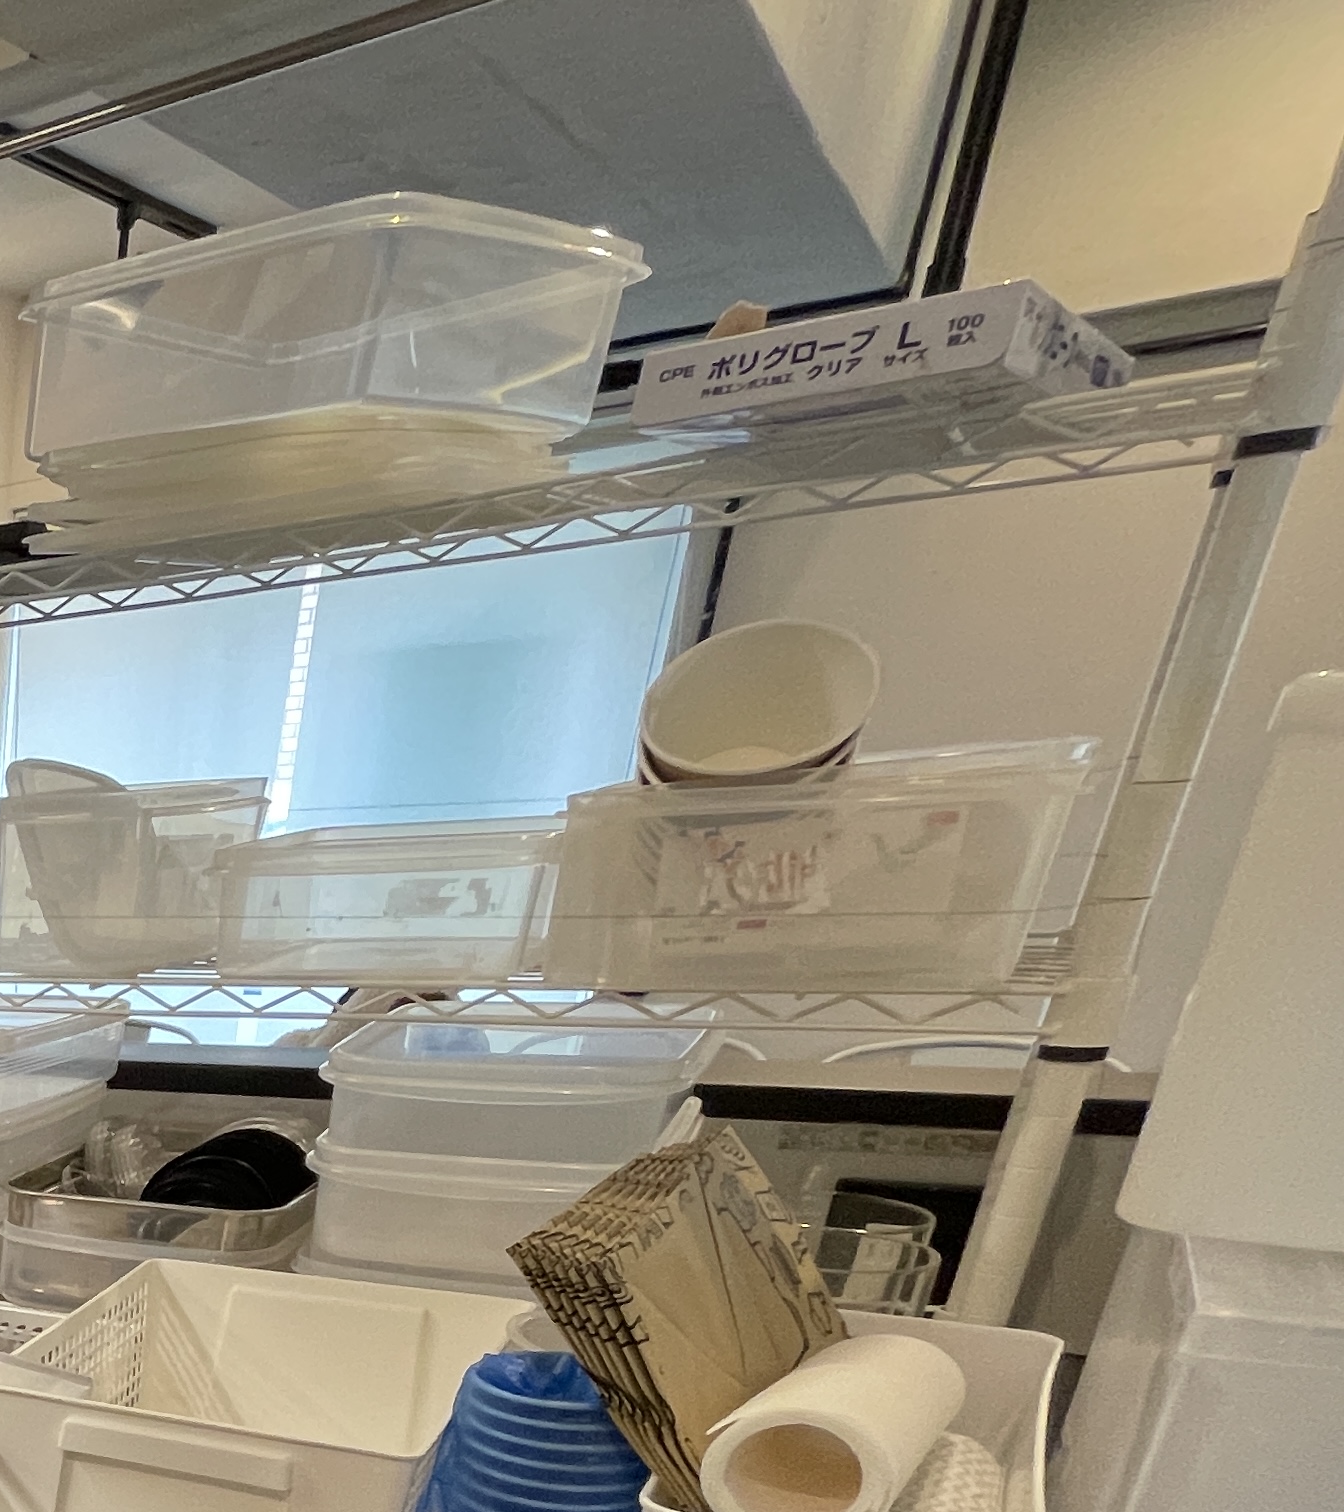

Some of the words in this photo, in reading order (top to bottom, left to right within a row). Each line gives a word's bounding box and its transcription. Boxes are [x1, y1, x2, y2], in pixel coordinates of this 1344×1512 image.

[947, 313, 986, 332] 100
[659, 364, 696, 383] CPE
[708, 326, 879, 379] ポリグローブ
[896, 321, 922, 350] L
[806, 356, 864, 381] クリア
[883, 347, 928, 367] サイズ
